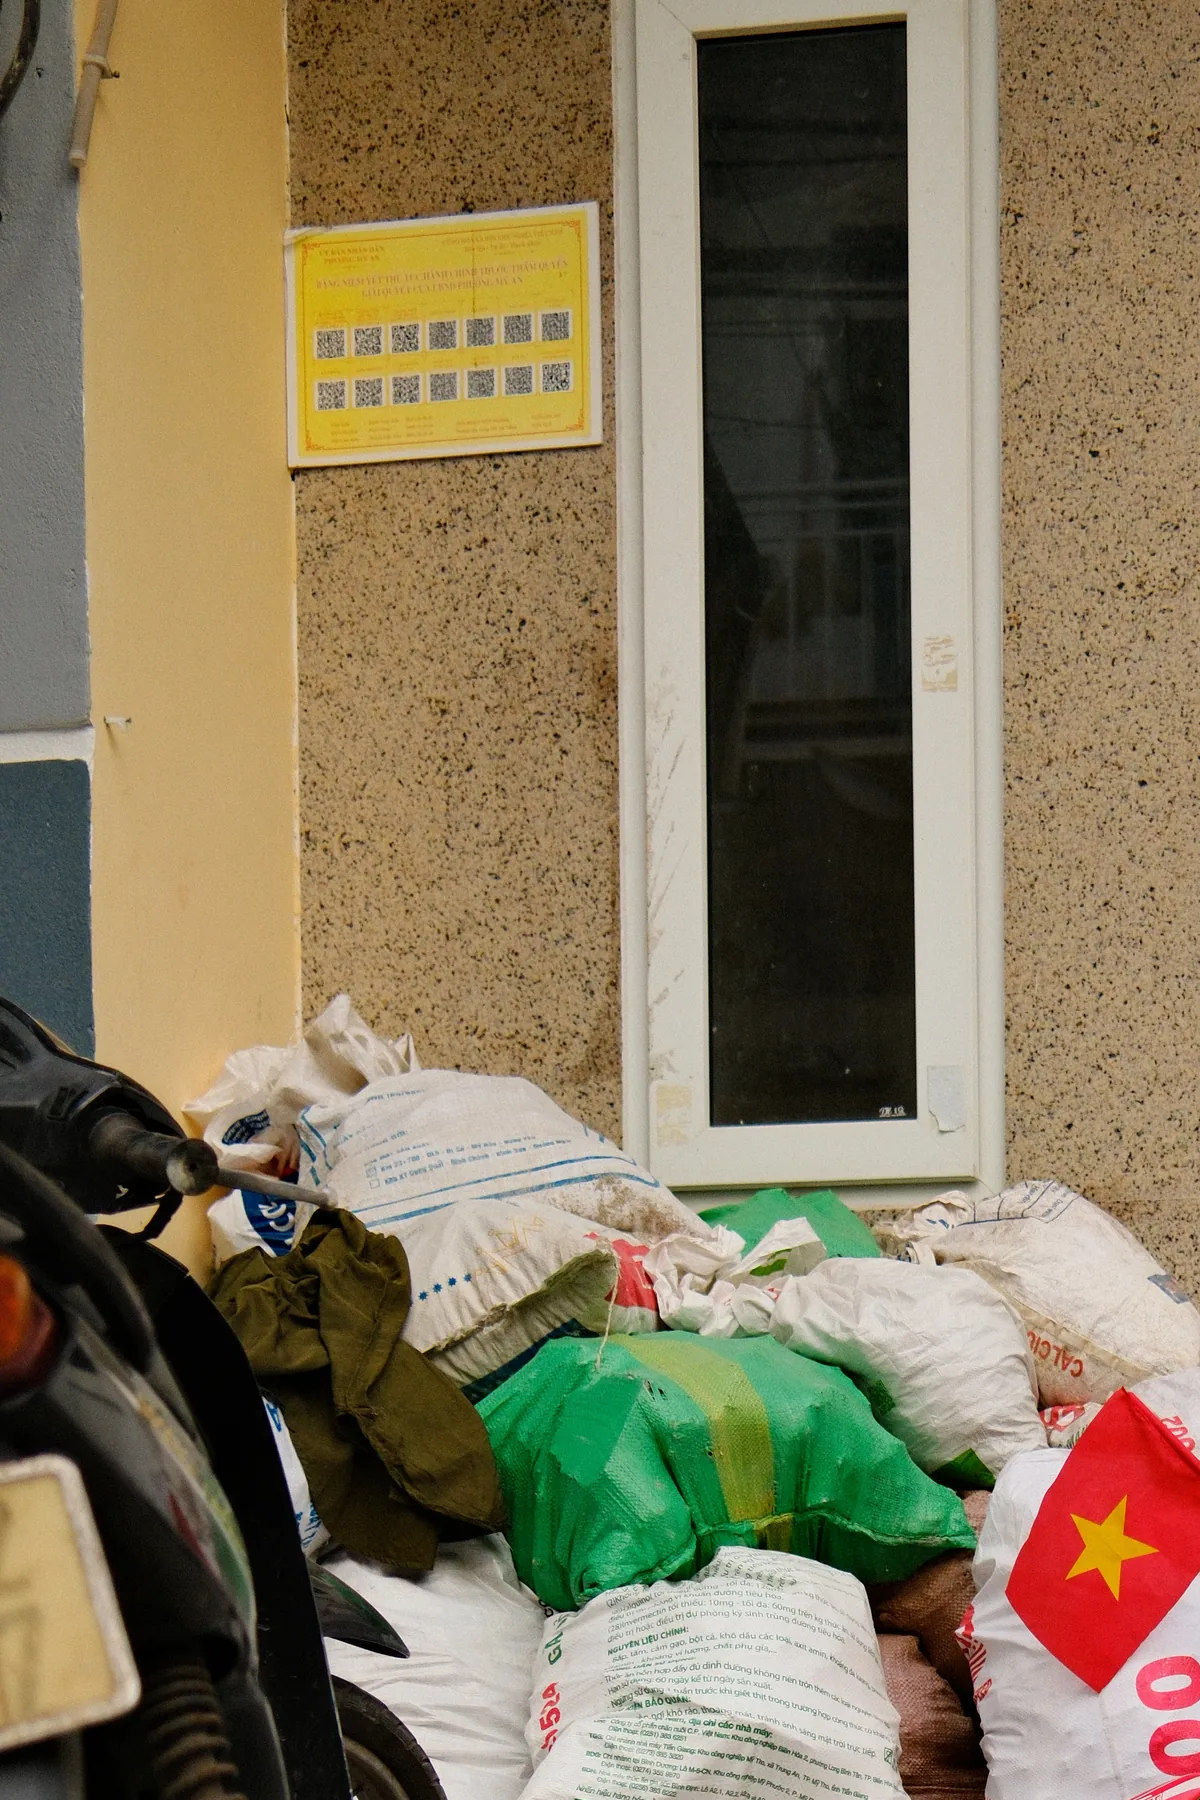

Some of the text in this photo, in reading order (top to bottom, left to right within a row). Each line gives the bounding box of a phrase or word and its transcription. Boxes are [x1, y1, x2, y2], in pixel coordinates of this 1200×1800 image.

[700, 1610, 730, 1619] phòng
[745, 1610, 764, 1618] sinh
[709, 1600, 734, 1609] 10mg
[772, 1603, 796, 1616] 60mg
[608, 1627, 690, 1656] NGUYÊN LIỆU CHÍNH:
[703, 1661, 722, 1670] dinh
[754, 1668, 781, 1682] không
[782, 1675, 797, 1685] nên
[656, 1676, 667, 1684] 60
[668, 1675, 689, 1686] ngày
[714, 1675, 735, 1686] ngày
[645, 1696, 664, 1708] BẢO
[720, 1687, 733, 1695] khi
[768, 1696, 791, 1709] trong
[718, 1720, 734, 1731] các
[736, 1723, 752, 1733] nhà
